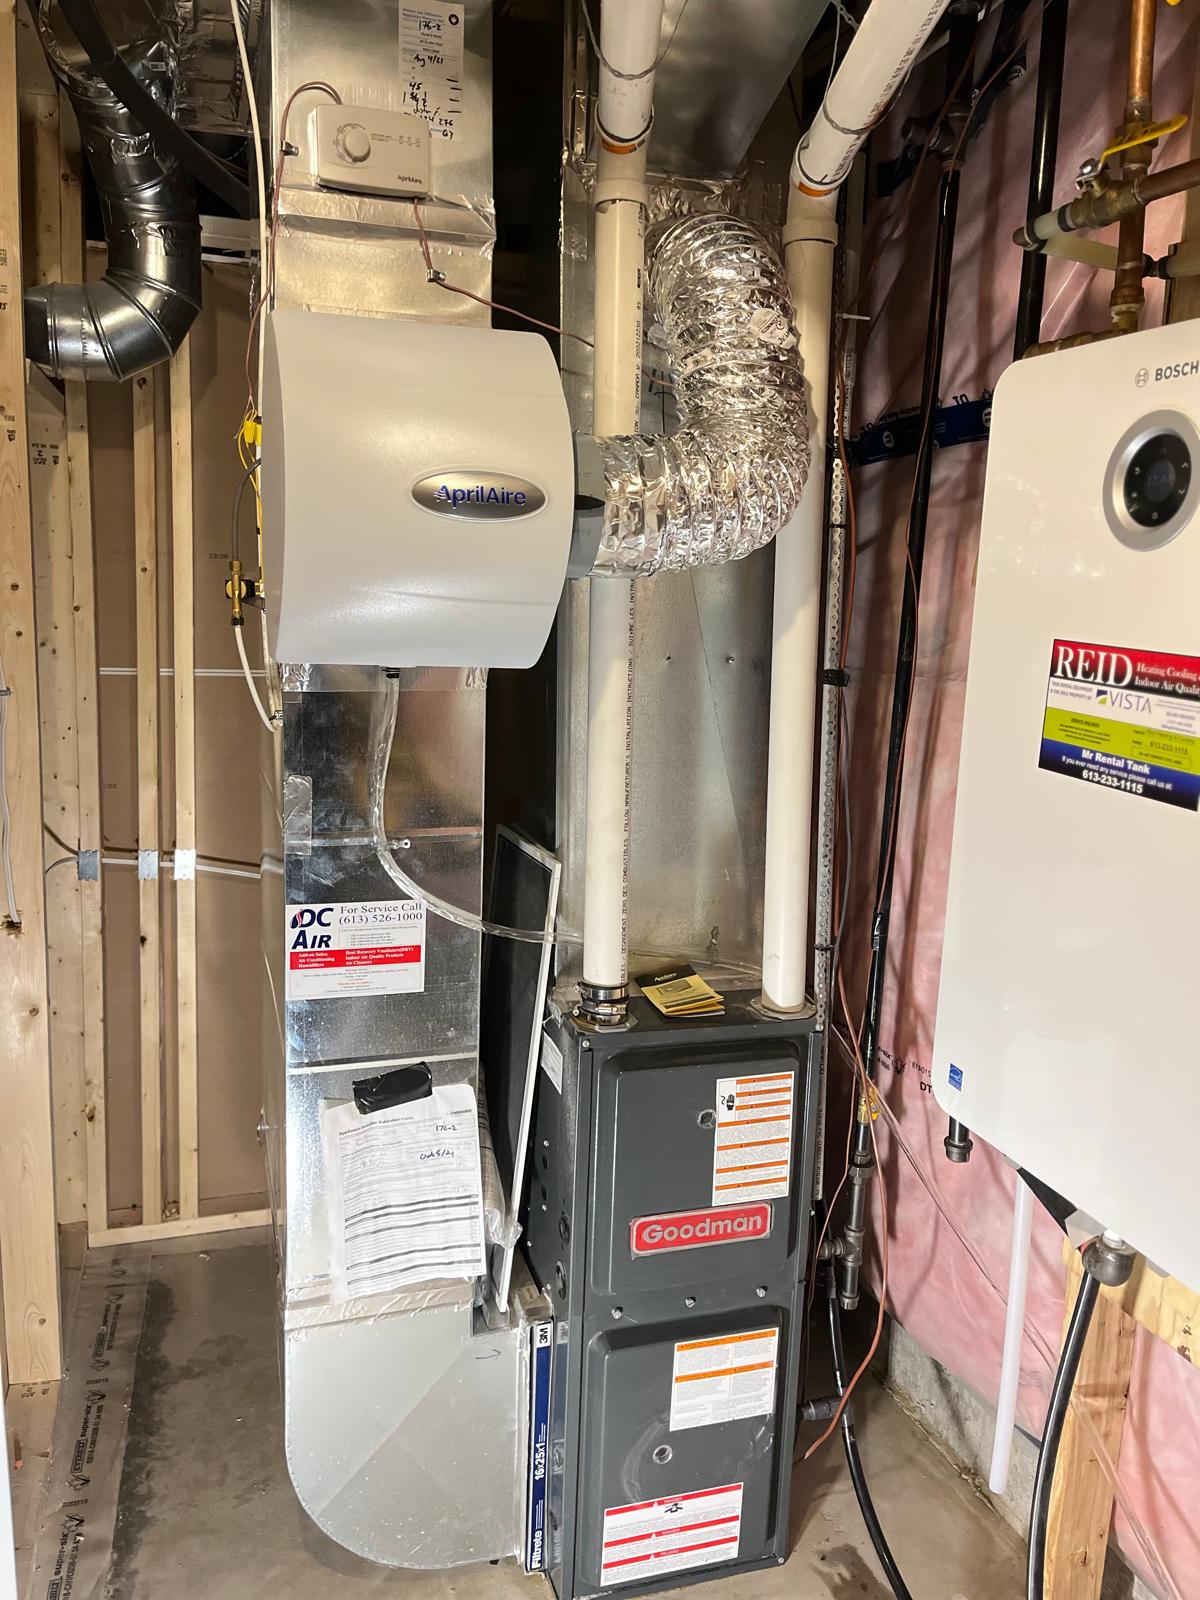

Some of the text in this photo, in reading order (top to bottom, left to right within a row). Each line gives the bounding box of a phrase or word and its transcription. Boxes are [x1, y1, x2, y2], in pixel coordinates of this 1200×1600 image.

[1155, 360, 1199, 381] BOSCH
[433, 485, 526, 508] AprilAire
[1054, 646, 1132, 687] REID
[1136, 662, 1197, 682] Heating Cooling
[1134, 676, 1160, 689] Indoor
[1161, 681, 1174, 690] Air
[1109, 690, 1152, 714] VISTA
[1082, 748, 1094, 759] Mr
[1095, 752, 1124, 768] Rental
[1126, 760, 1150, 774] Tank
[1082, 770, 1144, 794] 613-233-1115
[340, 902, 422, 914] For Service Call
[340, 912, 422, 925] (613) 526-1000
[643, 1214, 762, 1244] Goodman
[539, 1327, 548, 1344] 3M
[534, 1442, 546, 1480] 16x25x1
[532, 1530, 543, 1570] Filtrete
